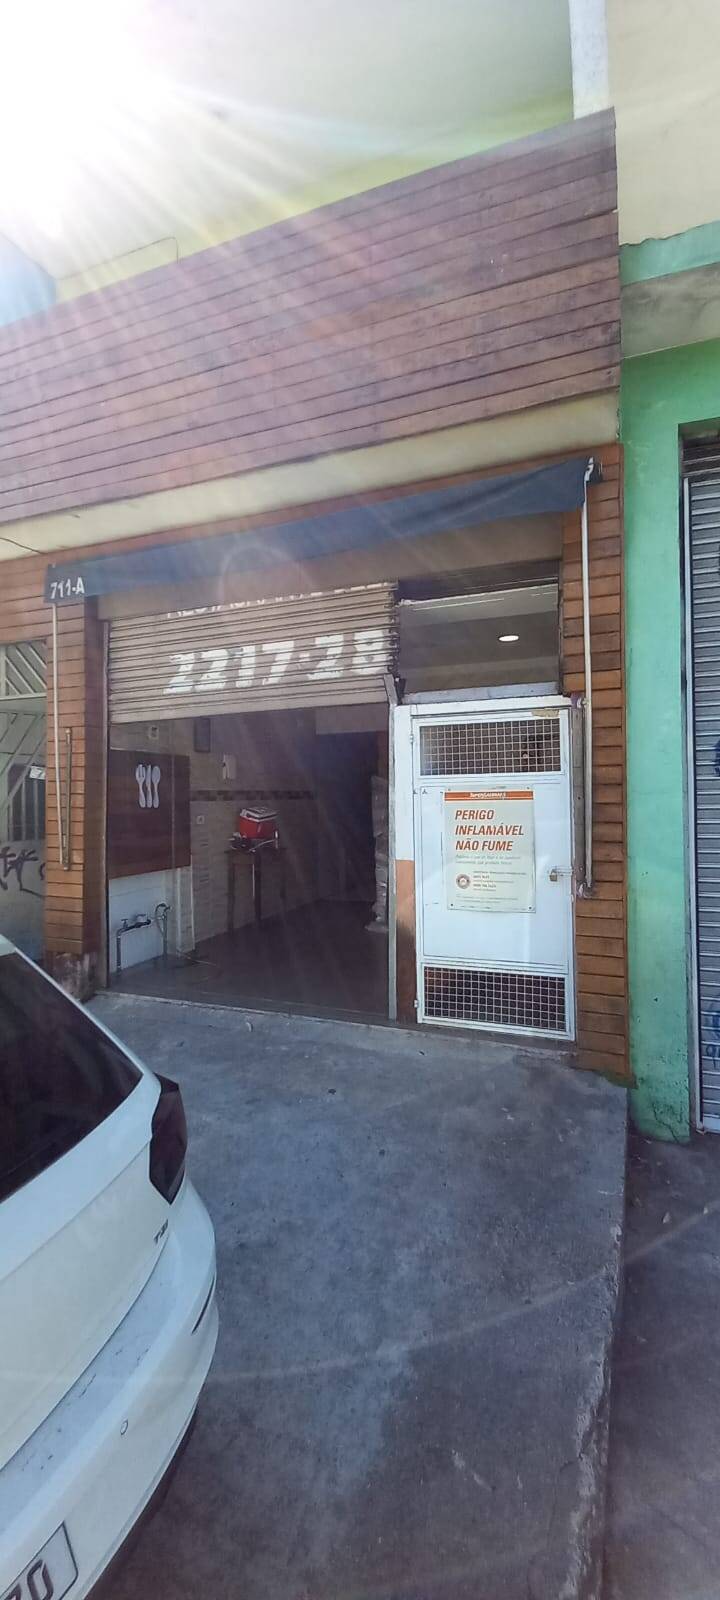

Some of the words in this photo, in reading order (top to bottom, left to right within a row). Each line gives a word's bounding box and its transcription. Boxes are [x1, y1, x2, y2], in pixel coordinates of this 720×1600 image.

[49, 576, 85, 600] 711-A
[455, 809, 495, 820] PERIGO
[455, 822, 524, 836] INFLAMÁVEL
[455, 837, 480, 851] NÃO
[481, 840, 514, 851] FUME
